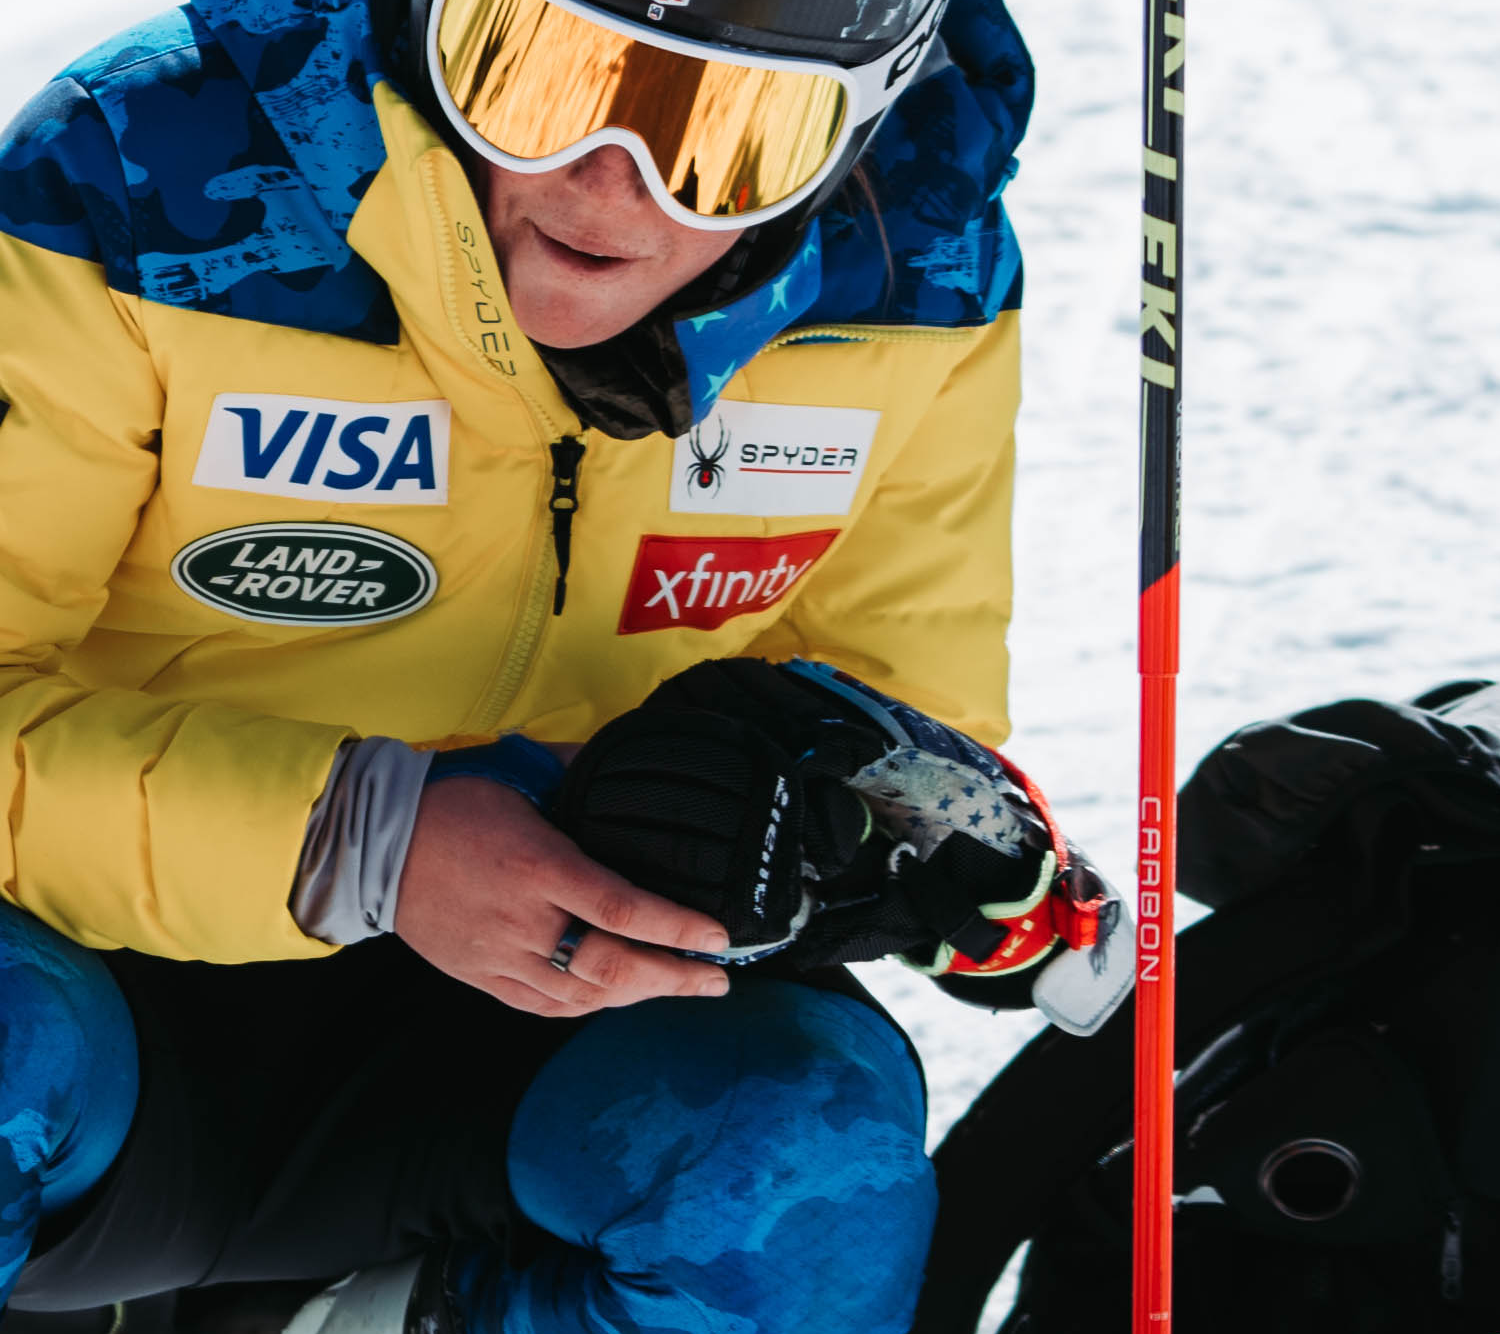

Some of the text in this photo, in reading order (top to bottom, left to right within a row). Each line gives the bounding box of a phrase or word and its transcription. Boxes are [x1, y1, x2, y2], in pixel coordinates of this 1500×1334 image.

[222, 407, 437, 492] VISA
[739, 443, 857, 468] SPYDER
[231, 543, 359, 578] LAND
[645, 551, 814, 619] xfinity
[231, 572, 387, 608] ROVER
[1139, 795, 1162, 982] CARBON
